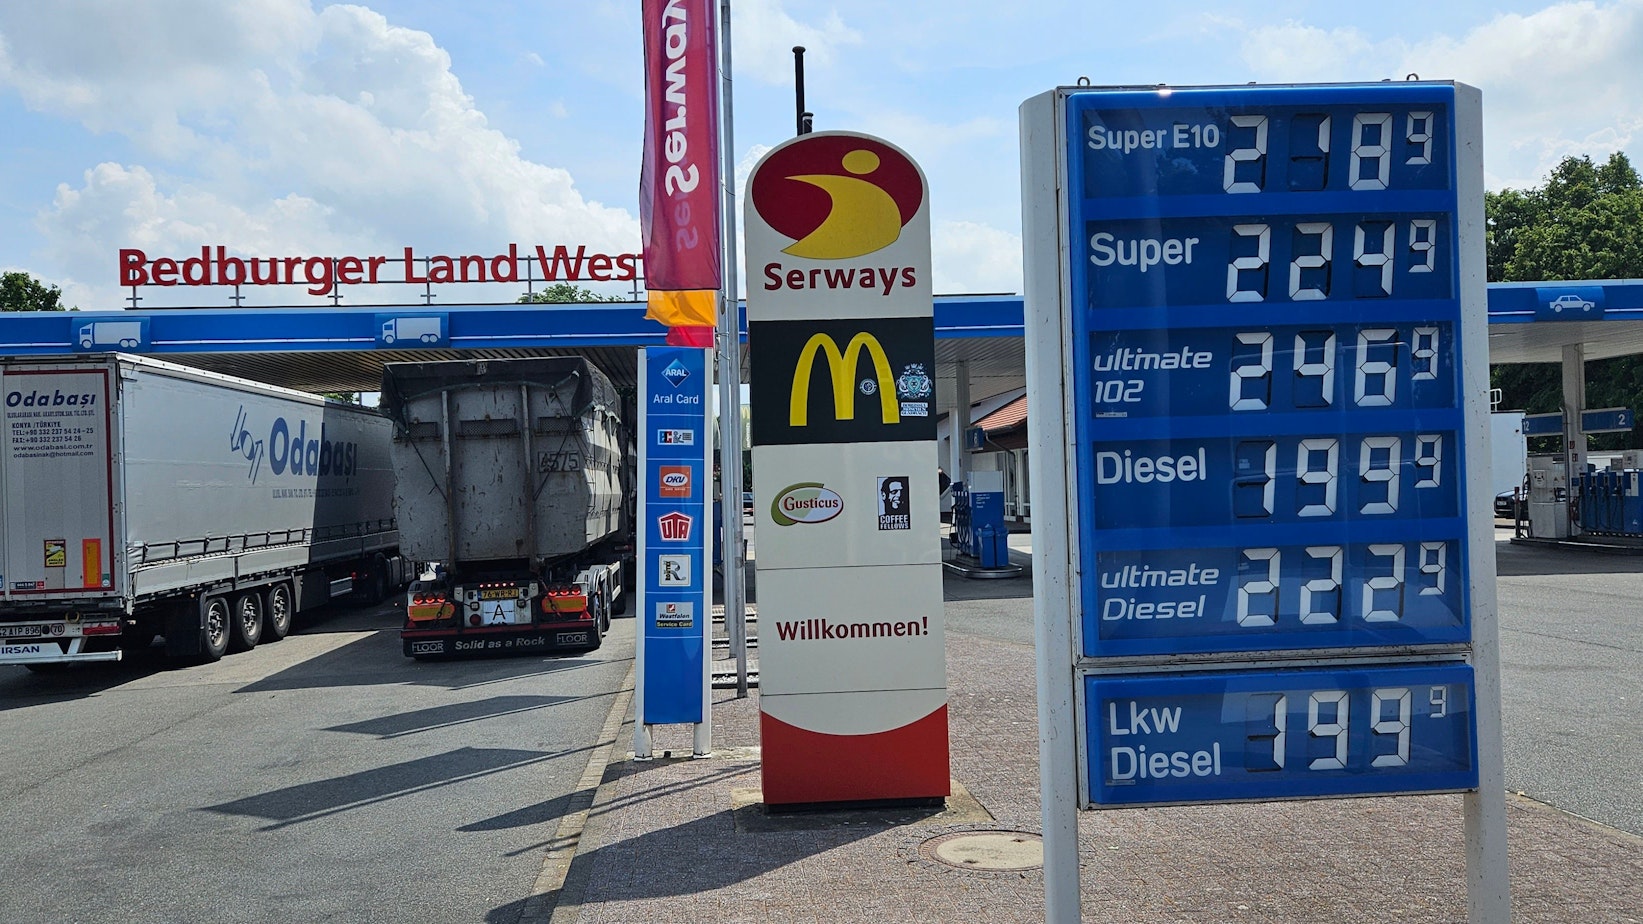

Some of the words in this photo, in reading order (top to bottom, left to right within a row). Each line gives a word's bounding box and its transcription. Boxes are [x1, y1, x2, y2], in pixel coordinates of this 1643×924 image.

[1088, 126, 1167, 154] Super
[1173, 124, 1220, 149] E10
[1089, 232, 1200, 272] Super
[119, 245, 386, 296] Bedburger
[404, 243, 518, 284] Land
[764, 263, 917, 296] Serways
[1094, 346, 1213, 372] ultimate
[665, 369, 687, 377] ARAL
[653, 394, 673, 404] Aral
[676, 394, 699, 405] Card
[1095, 380, 1144, 403] 102
[1522, 421, 1530, 431] 12
[1618, 413, 1626, 425] 2
[1096, 447, 1207, 485] Diesel
[783, 496, 840, 511] Gusticus
[660, 513, 690, 539] UTA
[880, 514, 909, 524] COFFEE
[1101, 563, 1220, 589] ultimate
[493, 604, 506, 620] A
[1102, 595, 1206, 622] Diesel
[53, 625, 63, 633] 70
[556, 633, 588, 643] FLOOR
[776, 616, 929, 641] Willkommen!
[1, 645, 40, 654] IRSAN
[412, 641, 444, 652] FLOOR
[455, 638, 484, 650] Solid
[488, 640, 502, 648] as
[516, 636, 546, 646] Rock
[1109, 701, 1182, 735] Lkw
[1111, 742, 1221, 780] Diesel
